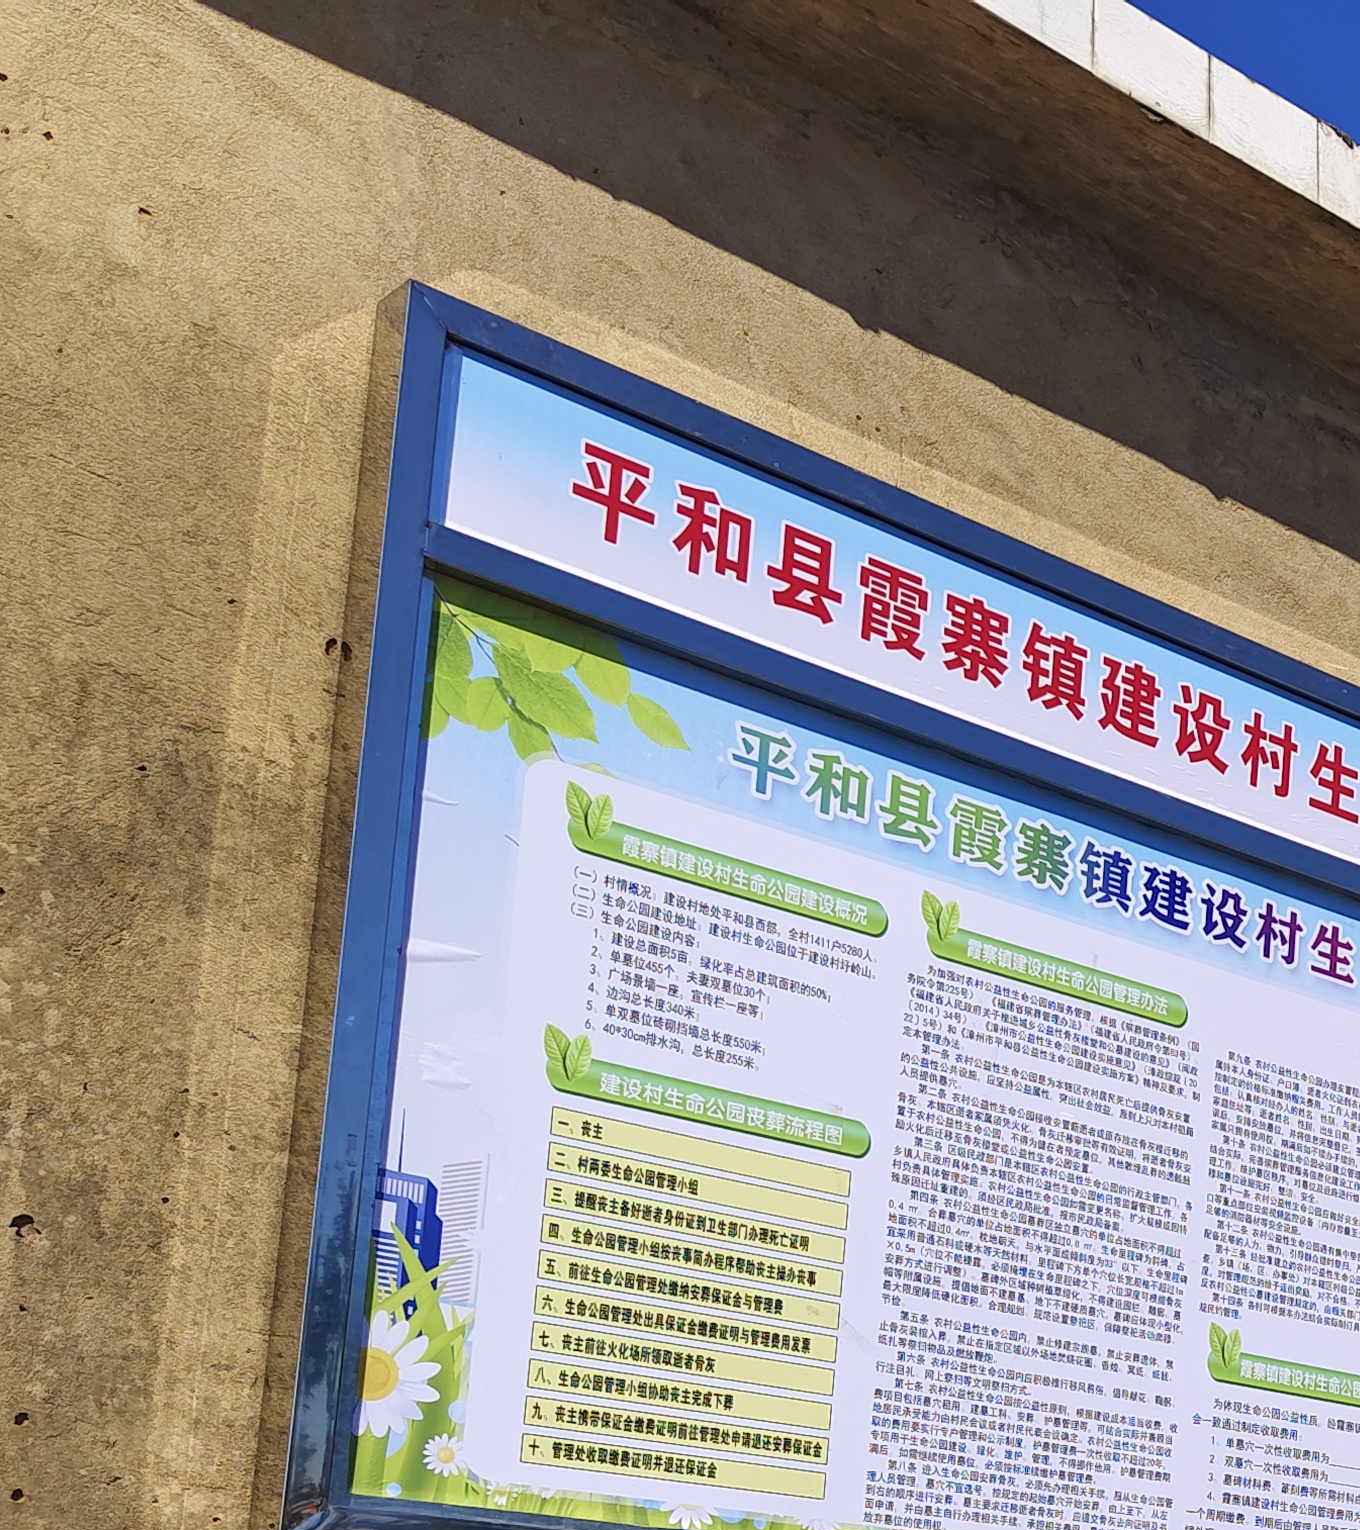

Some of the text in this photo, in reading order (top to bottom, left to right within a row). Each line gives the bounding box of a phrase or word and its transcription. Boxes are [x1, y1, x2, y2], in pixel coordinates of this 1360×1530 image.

[621, 832, 869, 928] 霞寨镇建设村生命公园建设概况
[966, 937, 1168, 1018] 霞寨镇建设村生命公园管理办法
[920, 1041, 950, 1062] 第一条
[1227, 1050, 1252, 1068] 第九条
[917, 1081, 947, 1100] 第二条
[598, 1068, 844, 1149] 建设村生命公园丧葬流程图
[557, 1113, 604, 1141] 一、丧主
[913, 1134, 943, 1153] 第三条
[1221, 1133, 1246, 1151] 第十条
[553, 1149, 699, 1197] 二、村两委生命公园管理小组
[909, 1187, 939, 1206] 第四条
[1218, 1182, 1251, 1201] 第十一条
[550, 1184, 810, 1253] 三、提醒丧主备好逝者身份证到卫生部门办理死亡证明
[1216, 1218, 1248, 1237] 第十二条
[547, 1218, 817, 1289] 四、生命公园管理小组按丧事简办程序帮助丧主操办丧事
[1214, 1242, 1247, 1261] 第十三条
[544, 1255, 784, 1317] 五、前往生命公园管理处缴纳安葬保证金与管理费
[1211, 1291, 1243, 1308] 第十四条
[541, 1291, 812, 1356] 六、生命公园管理处出具保证金缴费证明与管理费用发票
[899, 1308, 929, 1326] 第五条
[538, 1327, 716, 1375] 七、丧主前往火化场所领取逝者骨灰
[896, 1349, 926, 1366] 第六条
[534, 1363, 734, 1412] 八、生命公园管理小组协助丧主完成下葬
[893, 1376, 923, 1393] 第七条
[531, 1399, 823, 1459] 九、丧主携带保证金缴费证明前往管理处申请退还安葬保证金
[528, 1436, 718, 1480] 十、管理处收取缴费证明并退还保证金
[886, 1457, 917, 1474] 第八条
